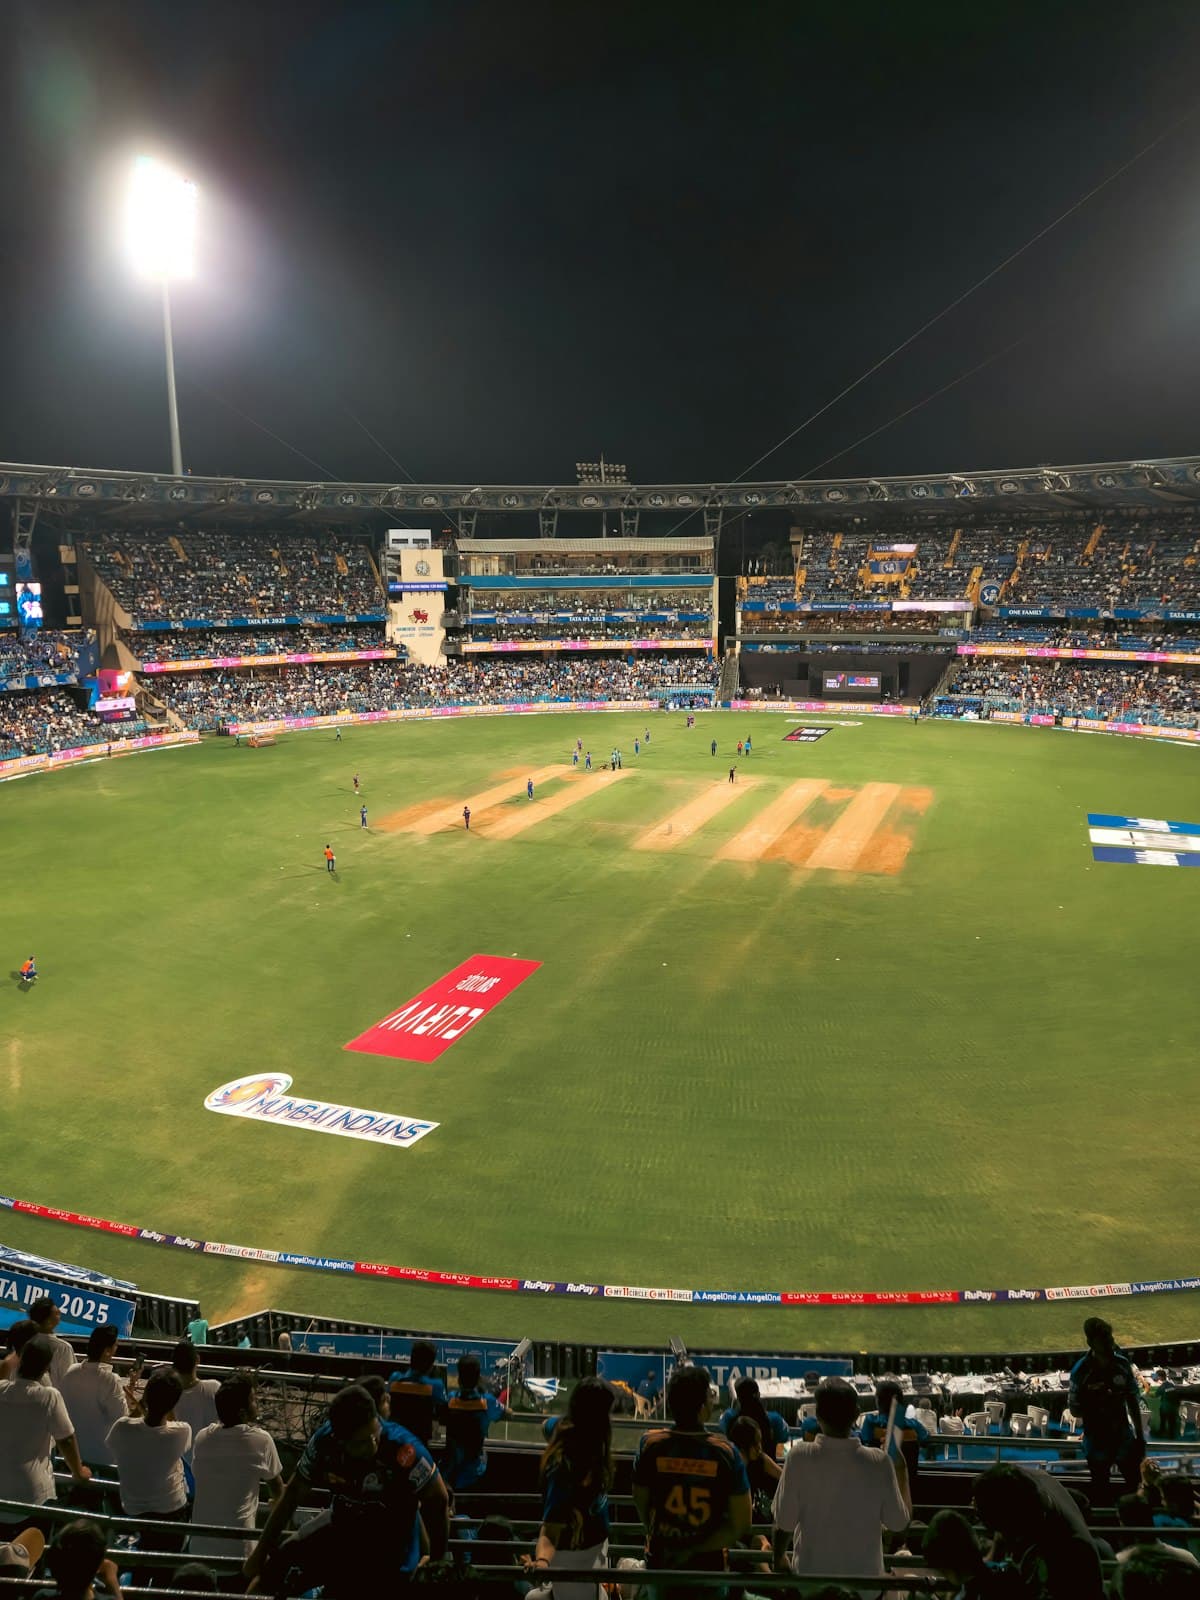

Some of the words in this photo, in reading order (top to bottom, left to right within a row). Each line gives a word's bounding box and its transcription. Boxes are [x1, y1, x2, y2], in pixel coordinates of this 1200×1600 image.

[378, 1000, 485, 1040] CURVV
[246, 1096, 339, 1124] MUMBAI
[328, 1110, 431, 1140] INDIANS
[140, 1229, 161, 1242] RuPay
[173, 1236, 196, 1249] RuPay
[524, 1280, 551, 1291] RuPay
[566, 1283, 594, 1295] RuPay
[964, 1290, 992, 1301] RuPay
[1008, 1290, 1036, 1300] RuPay
[59, 1293, 110, 1324] 2025
[664, 1485, 712, 1527] 45
